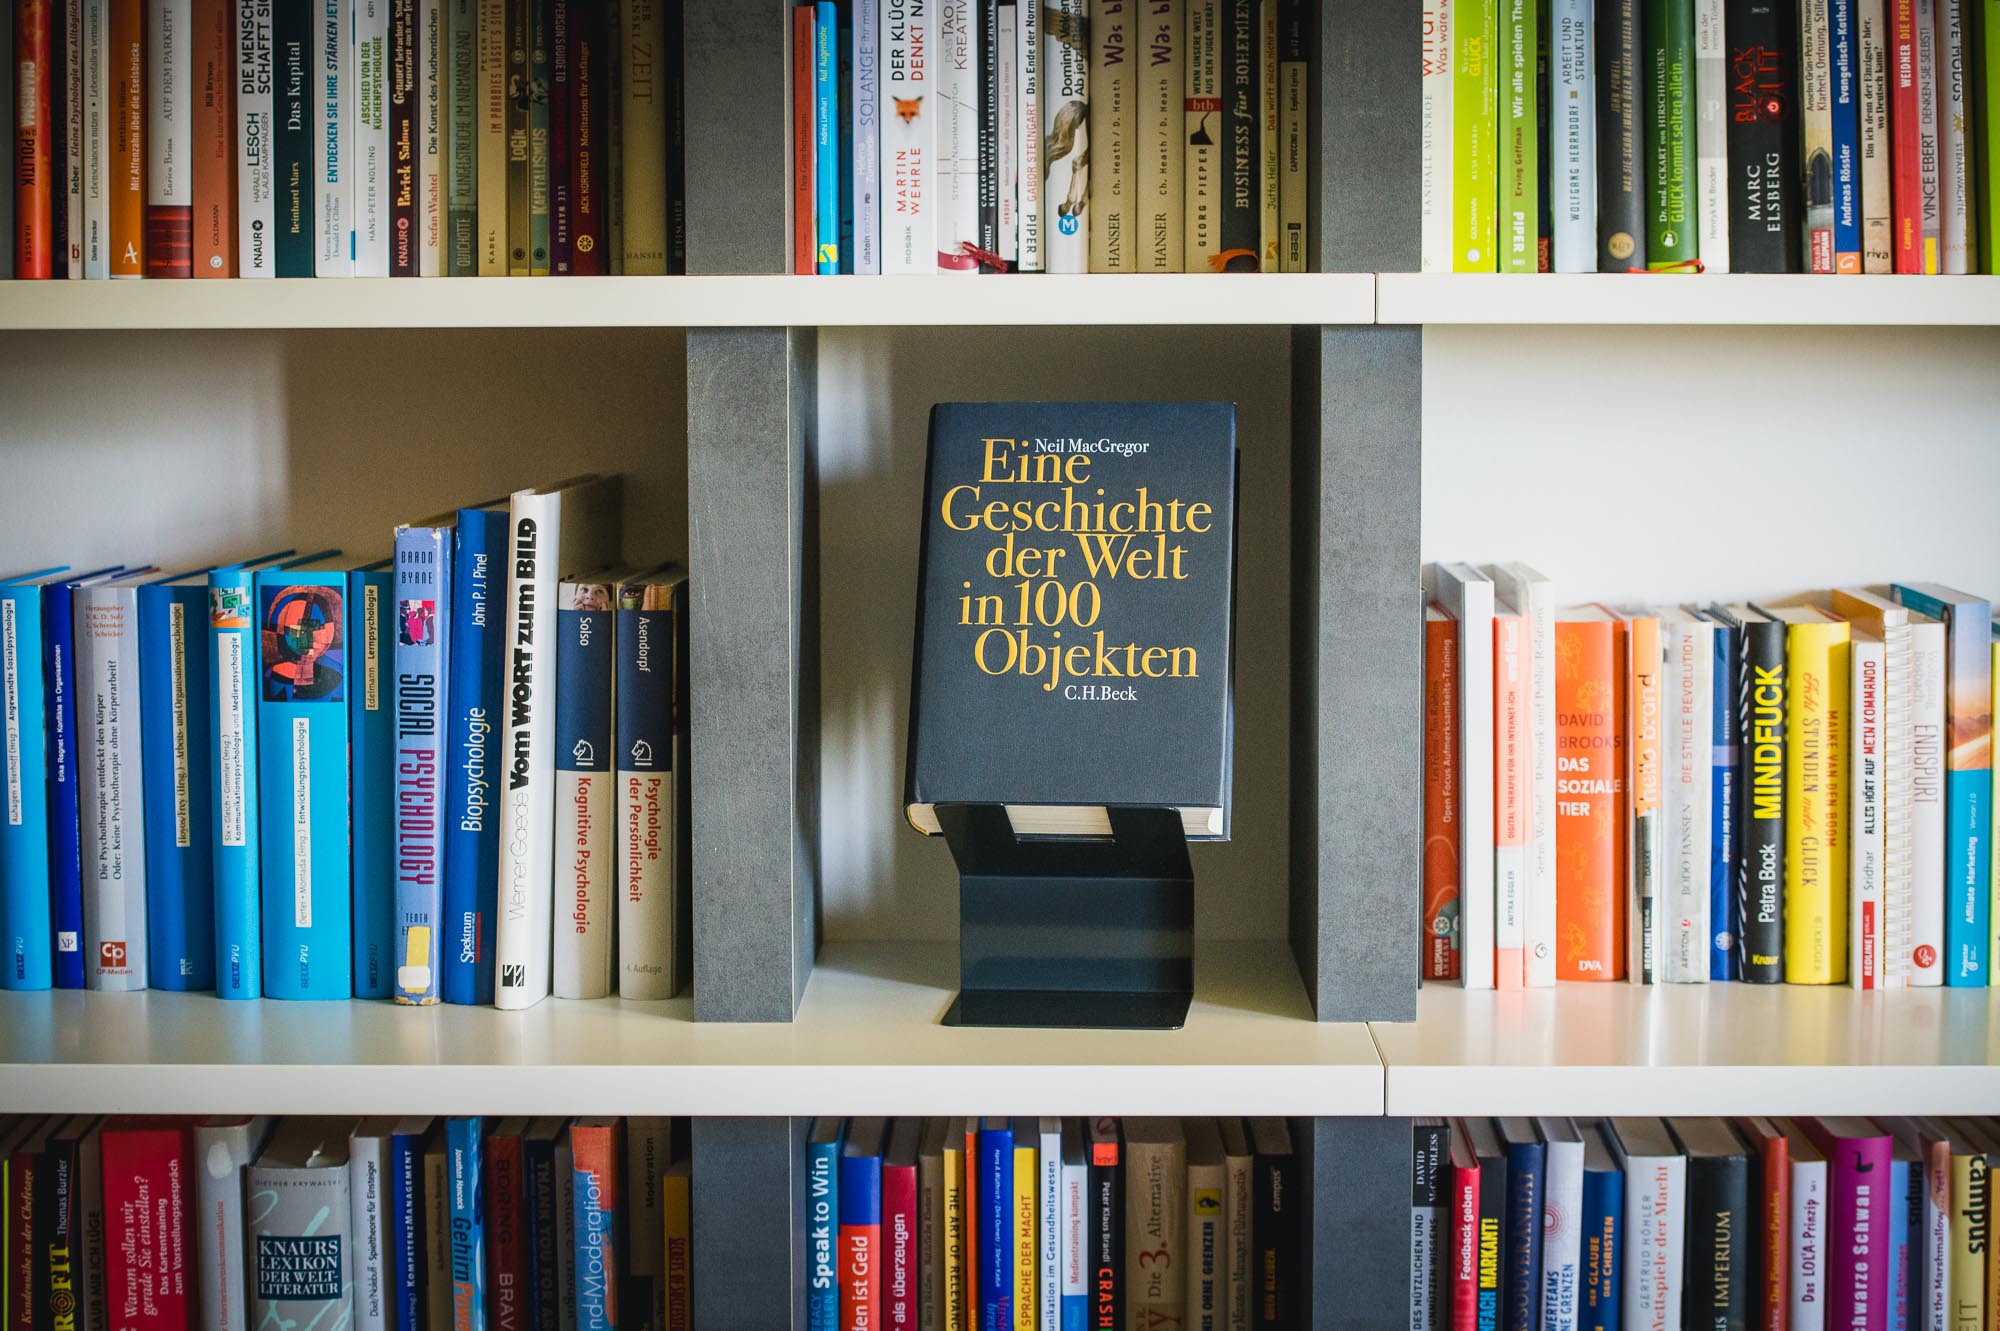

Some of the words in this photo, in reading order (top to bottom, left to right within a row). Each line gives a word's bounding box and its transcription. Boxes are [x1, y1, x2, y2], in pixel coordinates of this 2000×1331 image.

[325, 21, 337, 71] STÄRKEN
[427, 9, 437, 81] Authentischen
[1104, 25, 1124, 67] Was
[1513, 25, 1525, 69] spielen
[1562, 17, 1571, 41] UND
[71, 51, 79, 65] des
[130, 42, 140, 93] Eselsbrücke
[286, 42, 303, 96] Kapital
[1562, 45, 1571, 85] ARBEIT
[1574, 20, 1584, 80] STRUKTUR
[1902, 45, 1911, 88] WEIDNER
[70, 69, 81, 124] Psychologie
[327, 75, 337, 99] IHRE
[428, 85, 438, 101] des
[860, 46, 874, 125] SOLANGE
[1513, 72, 1523, 93] alle
[1670, 63, 1682, 97] allein
[130, 112, 140, 130] über
[131, 96, 140, 109] die
[288, 102, 301, 130] Das
[328, 102, 337, 118] SIE
[428, 104, 438, 133] Kunst
[1193, 100, 1214, 110] btb
[1514, 96, 1523, 118] Wir
[1670, 101, 1683, 137] selten
[70, 128, 79, 157] Kleine
[247, 112, 259, 166] LESCH
[328, 122, 338, 183] ENTDECKEN
[428, 137, 438, 154] Die
[1027, 102, 1036, 163] STEINGART
[1923, 133, 1934, 173] EBERT
[71, 166, 79, 194] Reber
[291, 162, 299, 187] Marx
[897, 150, 906, 212] MARTIN
[1199, 148, 1207, 196] PIEPER
[1235, 126, 1248, 208] BUSINESS
[1671, 140, 1684, 181] kommt
[1841, 144, 1850, 179] Rössler
[131, 177, 140, 191] Mit
[397, 166, 412, 207] Patrick
[428, 174, 438, 213] Wachtel
[911, 148, 921, 215] WEHRLE
[1027, 166, 1036, 202] GABOR
[1570, 168, 1580, 221] WOLFGANG
[1748, 165, 1760, 221] MARC
[1767, 153, 1780, 232] ELSBERG
[1924, 177, 1935, 221] VINCE
[291, 190, 300, 233] Reinhard
[1841, 183, 1851, 226] Andreas
[428, 216, 438, 247] Stefan
[1027, 214, 1036, 253] PIPER
[1109, 213, 1120, 267] HANSER
[1156, 213, 1166, 267] HANSER
[1199, 204, 1207, 247] GEORG
[254, 233, 262, 268] KNAUR
[1867, 251, 1889, 259] riva
[978, 439, 1090, 484] Eine
[1035, 439, 1065, 453] Neil
[1068, 439, 1149, 456] MacGregor
[941, 485, 1212, 533] Geschichte
[401, 551, 433, 564] BARON
[473, 553, 488, 579] Pinel
[517, 518, 537, 578] BILD
[985, 533, 1065, 578] der
[1072, 533, 1188, 579] Welt
[401, 571, 432, 584] BYRNE
[472, 592, 486, 600] P.
[473, 581, 486, 589] J.
[472, 603, 486, 628] John
[518, 585, 535, 645] zum
[958, 582, 1005, 625] in
[1013, 581, 1100, 627] 100
[5, 603, 14, 670] Sozialpsychologie
[579, 617, 592, 646] Solso
[638, 617, 651, 671] Asendorpf
[231, 637, 240, 711] Medienpsychologie
[974, 628, 1199, 691] Objekten
[6, 673, 15, 721] Angewandte
[399, 674, 435, 739] SOCIAL
[512, 648, 533, 727] WORT
[1864, 661, 1876, 723] KOMMANDO
[96, 693, 106, 726] Körper
[1559, 713, 1603, 726] DAVID
[97, 729, 105, 745] den
[1559, 736, 1622, 748] BROOKS
[1753, 664, 1783, 819] MINDFUCK
[1864, 726, 1875, 754] MEIN
[97, 749, 105, 788] entdeckt
[298, 721, 306, 824] Entwicklungspsychologie
[461, 708, 490, 833] Biopsychologie
[510, 731, 530, 790] Vom
[1558, 757, 1589, 772] DAS
[1865, 758, 1875, 775] AUF
[1914, 724, 1938, 804] ENDSPURT
[232, 731, 242, 841] Kommunikationspsychologie
[629, 778, 642, 801] der
[1558, 779, 1621, 794] SOZIALE
[1863, 777, 1875, 798] HÖRT
[98, 791, 110, 860] Psychotherapie
[399, 750, 435, 885] PSYCHOLOGY
[510, 792, 529, 857] Gaede
[577, 778, 591, 845] Kognitive
[648, 779, 662, 860] Psychologie
[1558, 802, 1590, 817] TIER
[1865, 801, 1875, 834] ALLES
[100, 863, 108, 879] Die
[629, 804, 642, 902] Persönlichkeit
[1759, 844, 1776, 876] Bock
[1966, 837, 1978, 881] Marketing
[509, 860, 528, 921] Werner
[572, 850, 590, 934] Psychologie
[1758, 879, 1776, 923] Petra
[1965, 884, 1974, 923] Affiliate
[406, 912, 428, 923] TENTH
[460, 912, 474, 963] Spektrum
[812, 1157, 829, 1197] Win
[1102, 1182, 1110, 1207] Peter
[1148, 1156, 1161, 1237] Alternative
[812, 1200, 830, 1224] to
[1021, 1195, 1031, 1237] MACHT
[1464, 1186, 1473, 1221] geben
[1853, 1185, 1869, 1254] Schwan
[158, 1199, 168, 1274] Kartentraining
[260, 1240, 338, 1255] KNAURS
[812, 1226, 833, 1288] Speak
[1022, 1241, 1031, 1266] DER
[1103, 1233, 1111, 1262] Brandl
[1139, 1240, 1170, 1270] 3.
[1461, 1225, 1471, 1280] Feedback
[1480, 1219, 1498, 1288] MARKANT!
[261, 1270, 290, 1282] DER
[294, 1270, 338, 1281] WELT-
[262, 1256, 337, 1270] LEXIKON
[1715, 1211, 1730, 1307] IMPERIUM
[160, 1276, 168, 1295] Das
[262, 1282, 337, 1295] LITERATUR
[1021, 1270, 1031, 1326] SPRACHE
[1099, 1268, 1113, 1327] CRASH
[1149, 1273, 1161, 1297] Die
